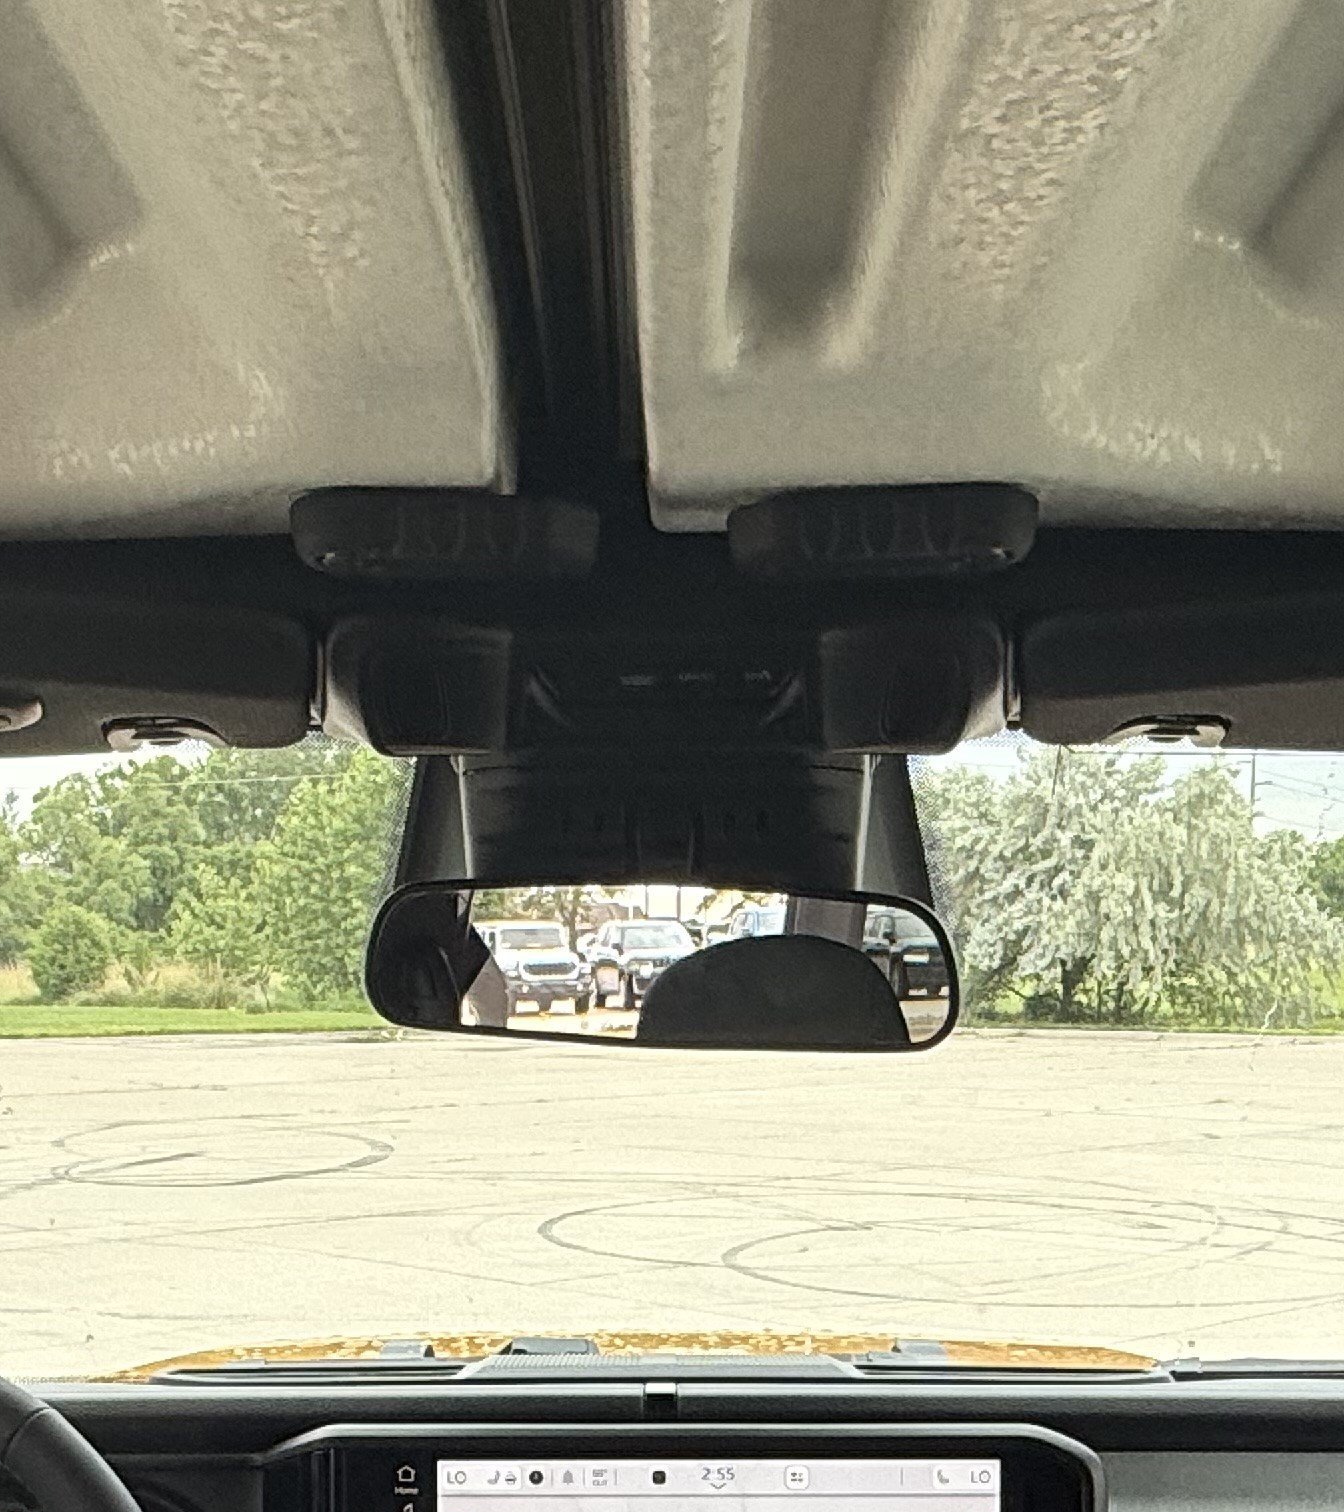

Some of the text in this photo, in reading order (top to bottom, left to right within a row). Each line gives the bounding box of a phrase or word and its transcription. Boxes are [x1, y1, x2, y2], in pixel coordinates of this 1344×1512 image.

[446, 1471, 467, 1484] LO
[700, 1467, 736, 1481] 2:55
[970, 1470, 992, 1484] LO
